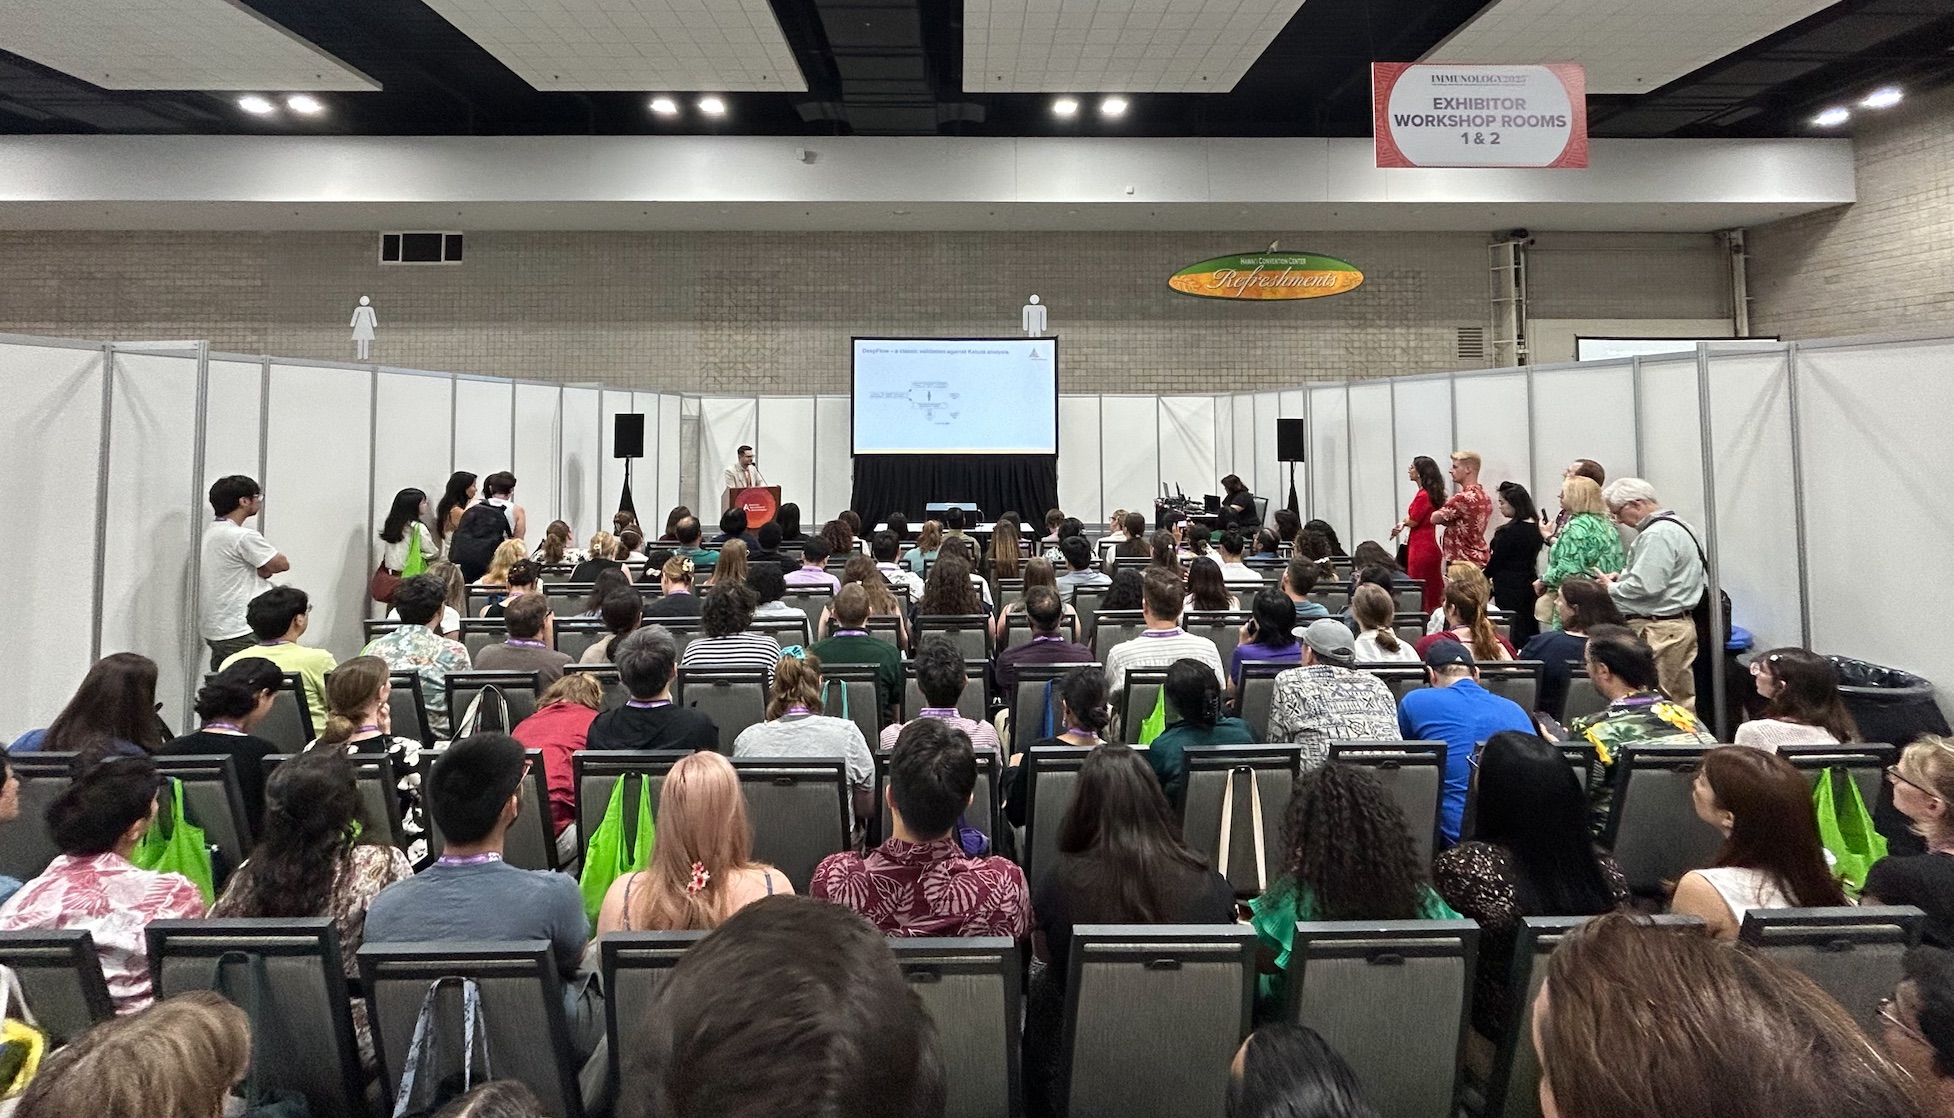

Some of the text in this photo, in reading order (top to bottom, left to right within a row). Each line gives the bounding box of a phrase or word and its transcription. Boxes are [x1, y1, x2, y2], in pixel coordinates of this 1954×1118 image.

[1433, 97, 1526, 110] EXHIBITOR
[1394, 114, 1566, 128] WORKSHOP ROOMS
[1461, 132, 1500, 145] 1 & 2
[1206, 265, 1337, 297] Refreshments
